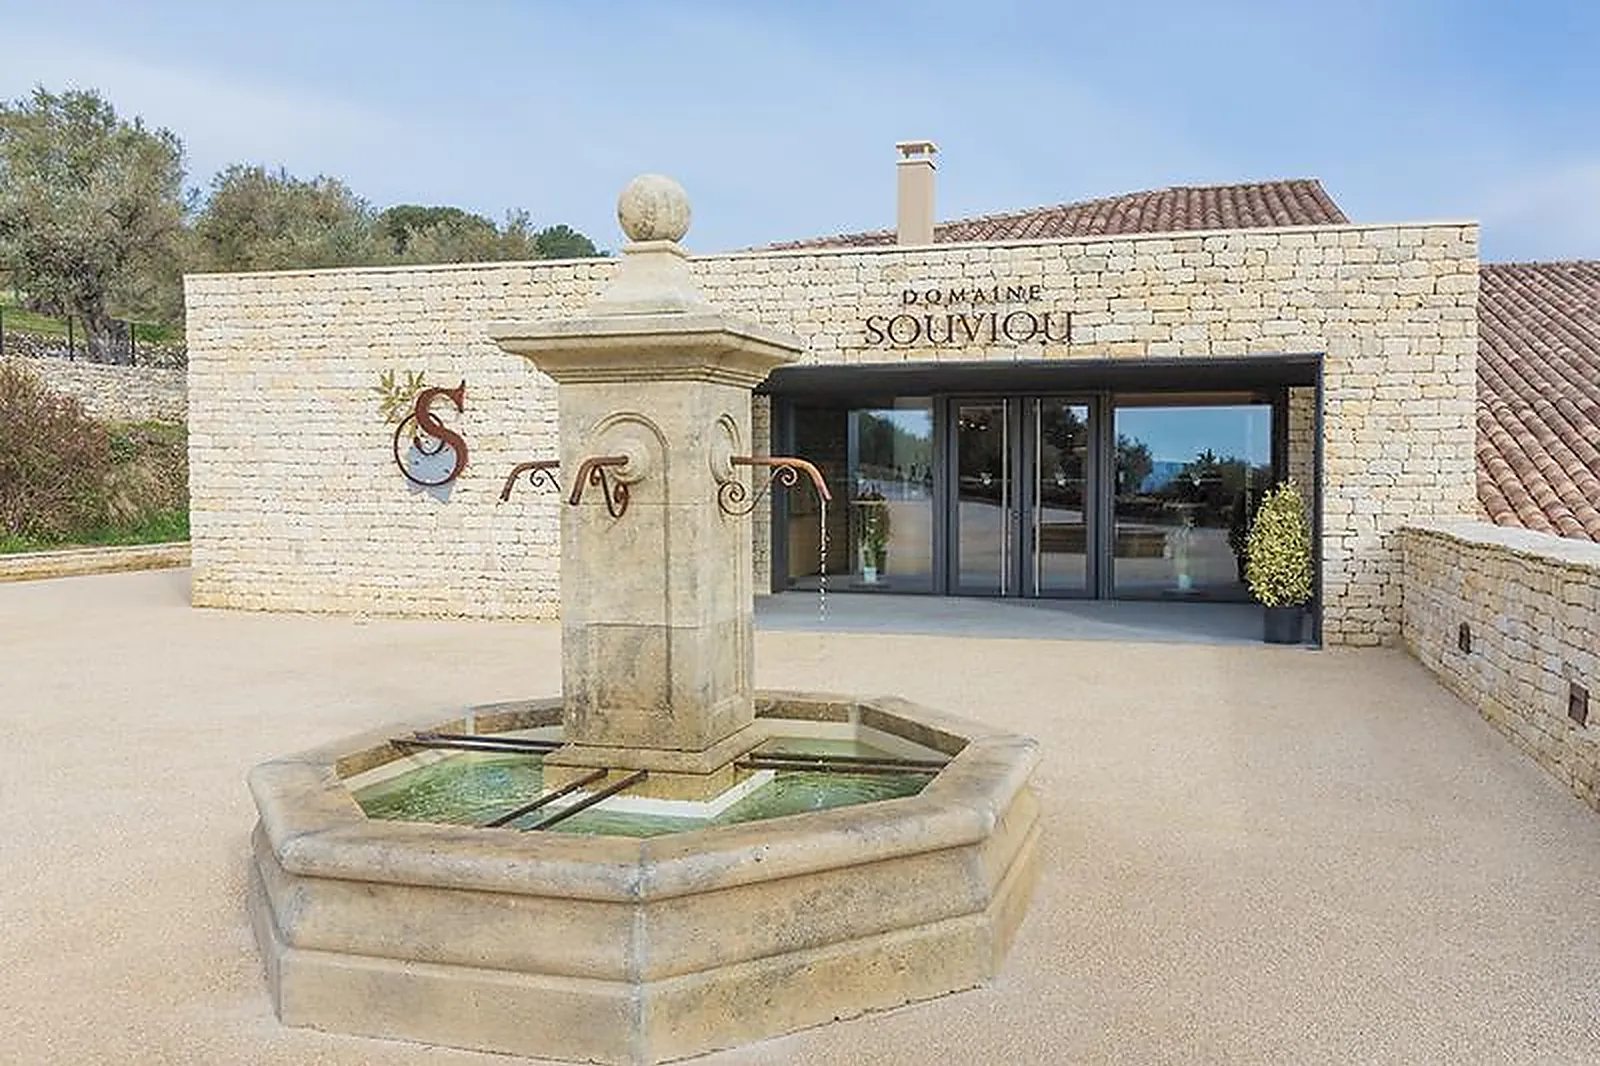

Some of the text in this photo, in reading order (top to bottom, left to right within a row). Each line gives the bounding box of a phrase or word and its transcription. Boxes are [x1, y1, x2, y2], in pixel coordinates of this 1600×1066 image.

[902, 284, 1043, 305] DOMAINE
[865, 310, 1073, 346] SOUVIOU
[396, 379, 469, 486] S
